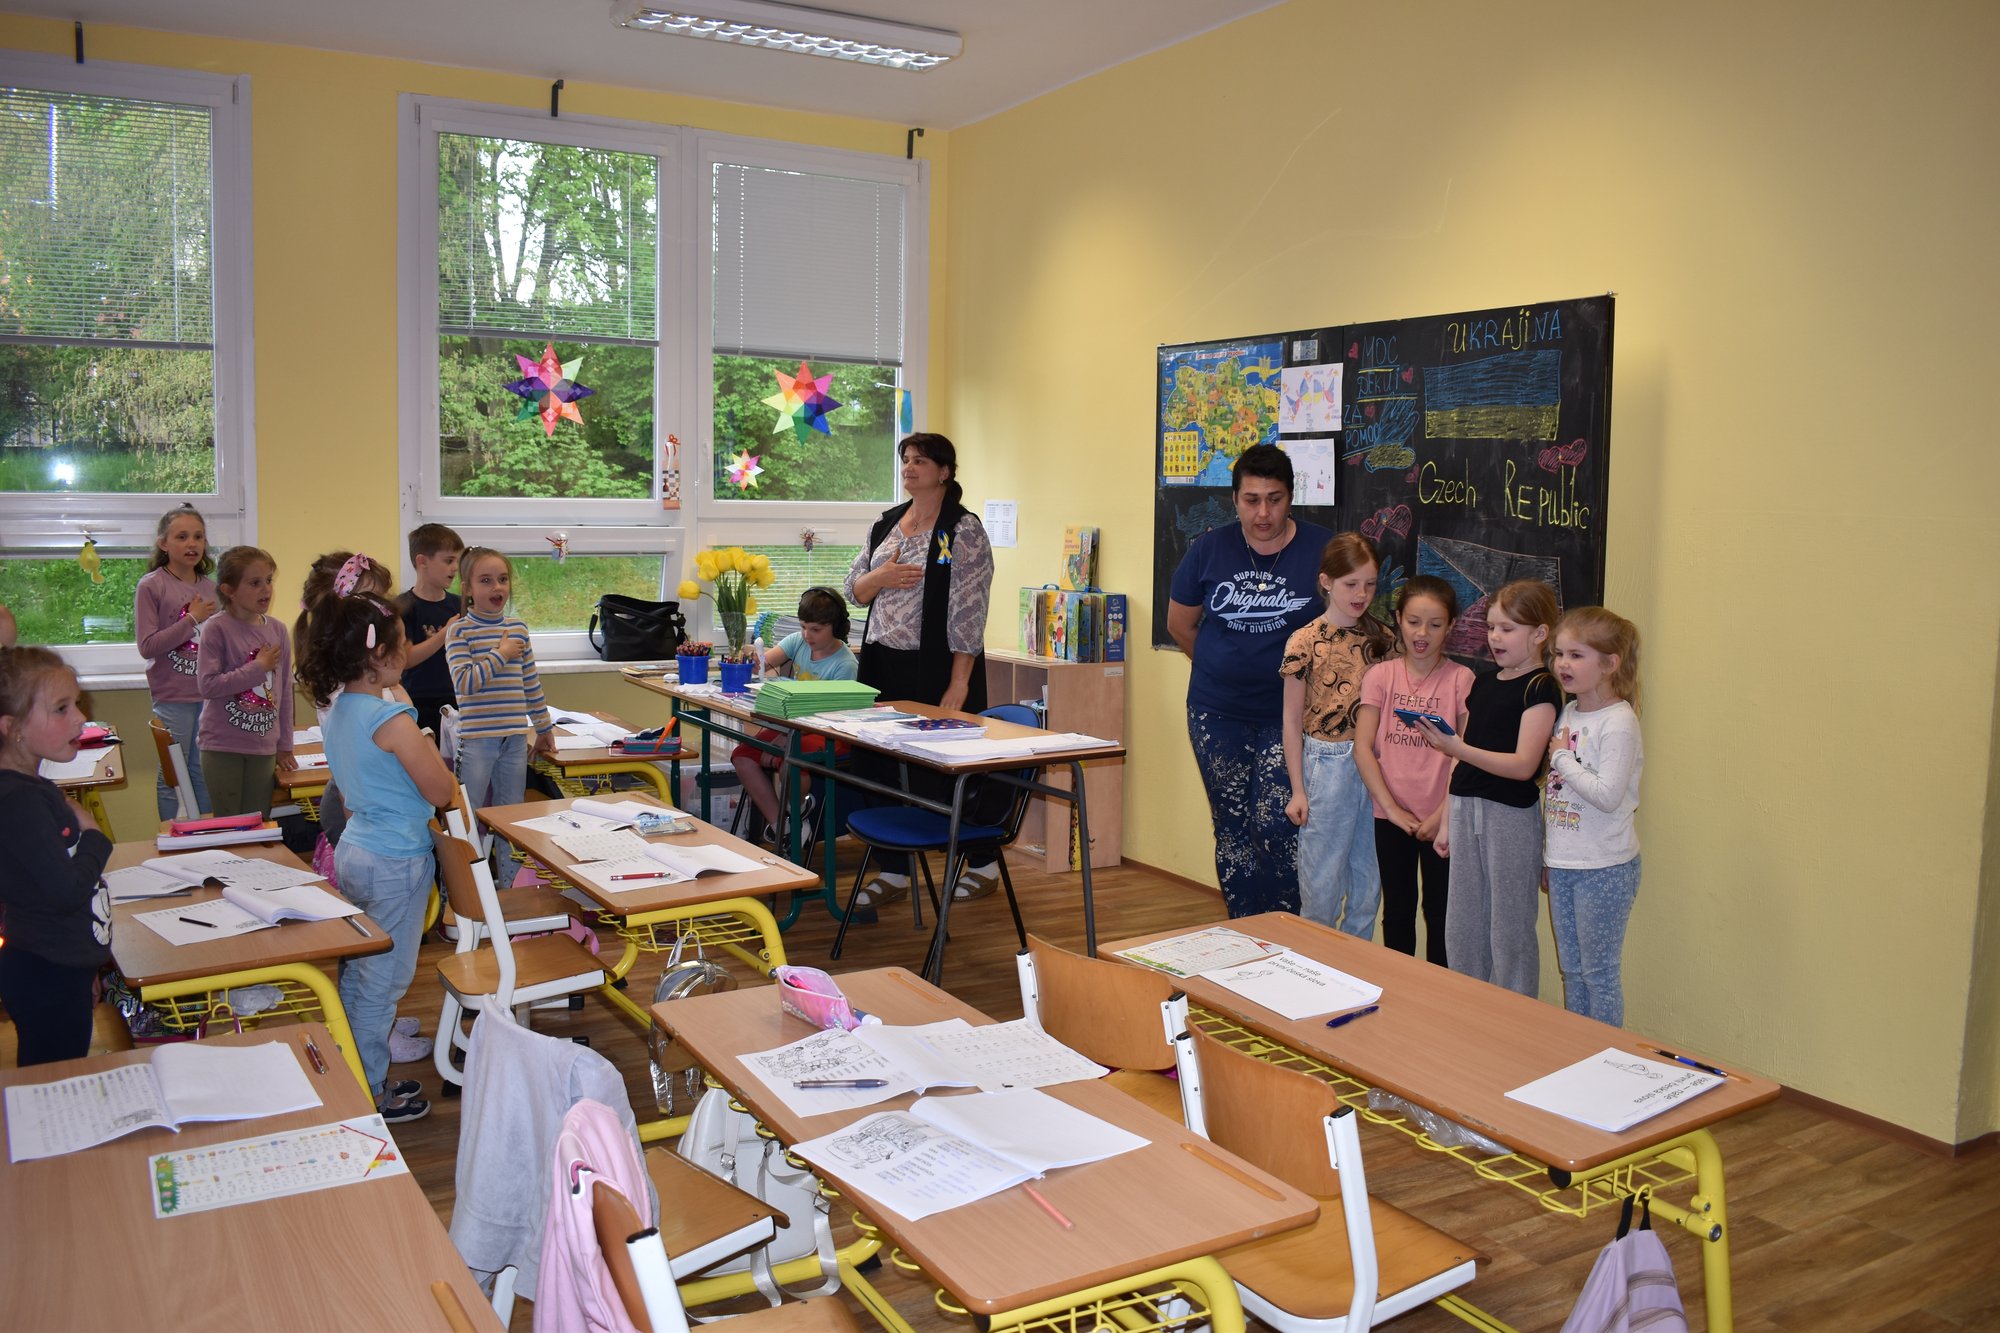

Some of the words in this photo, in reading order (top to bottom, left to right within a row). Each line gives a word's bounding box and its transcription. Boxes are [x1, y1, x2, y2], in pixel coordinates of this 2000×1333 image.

[1362, 335, 1398, 368] MOC
[1343, 404, 1362, 425] ZA
[1418, 457, 1476, 508] Czech
[1233, 570, 1273, 582] SUPPLIES
[1275, 576, 1287, 586] CO.
[1241, 581, 1257, 591] The
[1211, 581, 1289, 614] Originals
[1250, 617, 1287, 634] DIVISION
[1393, 692, 1441, 709] PERFECT
[229, 715, 240, 726] is
[241, 720, 273, 737] magic
[1384, 731, 1436, 749] MORNIN
